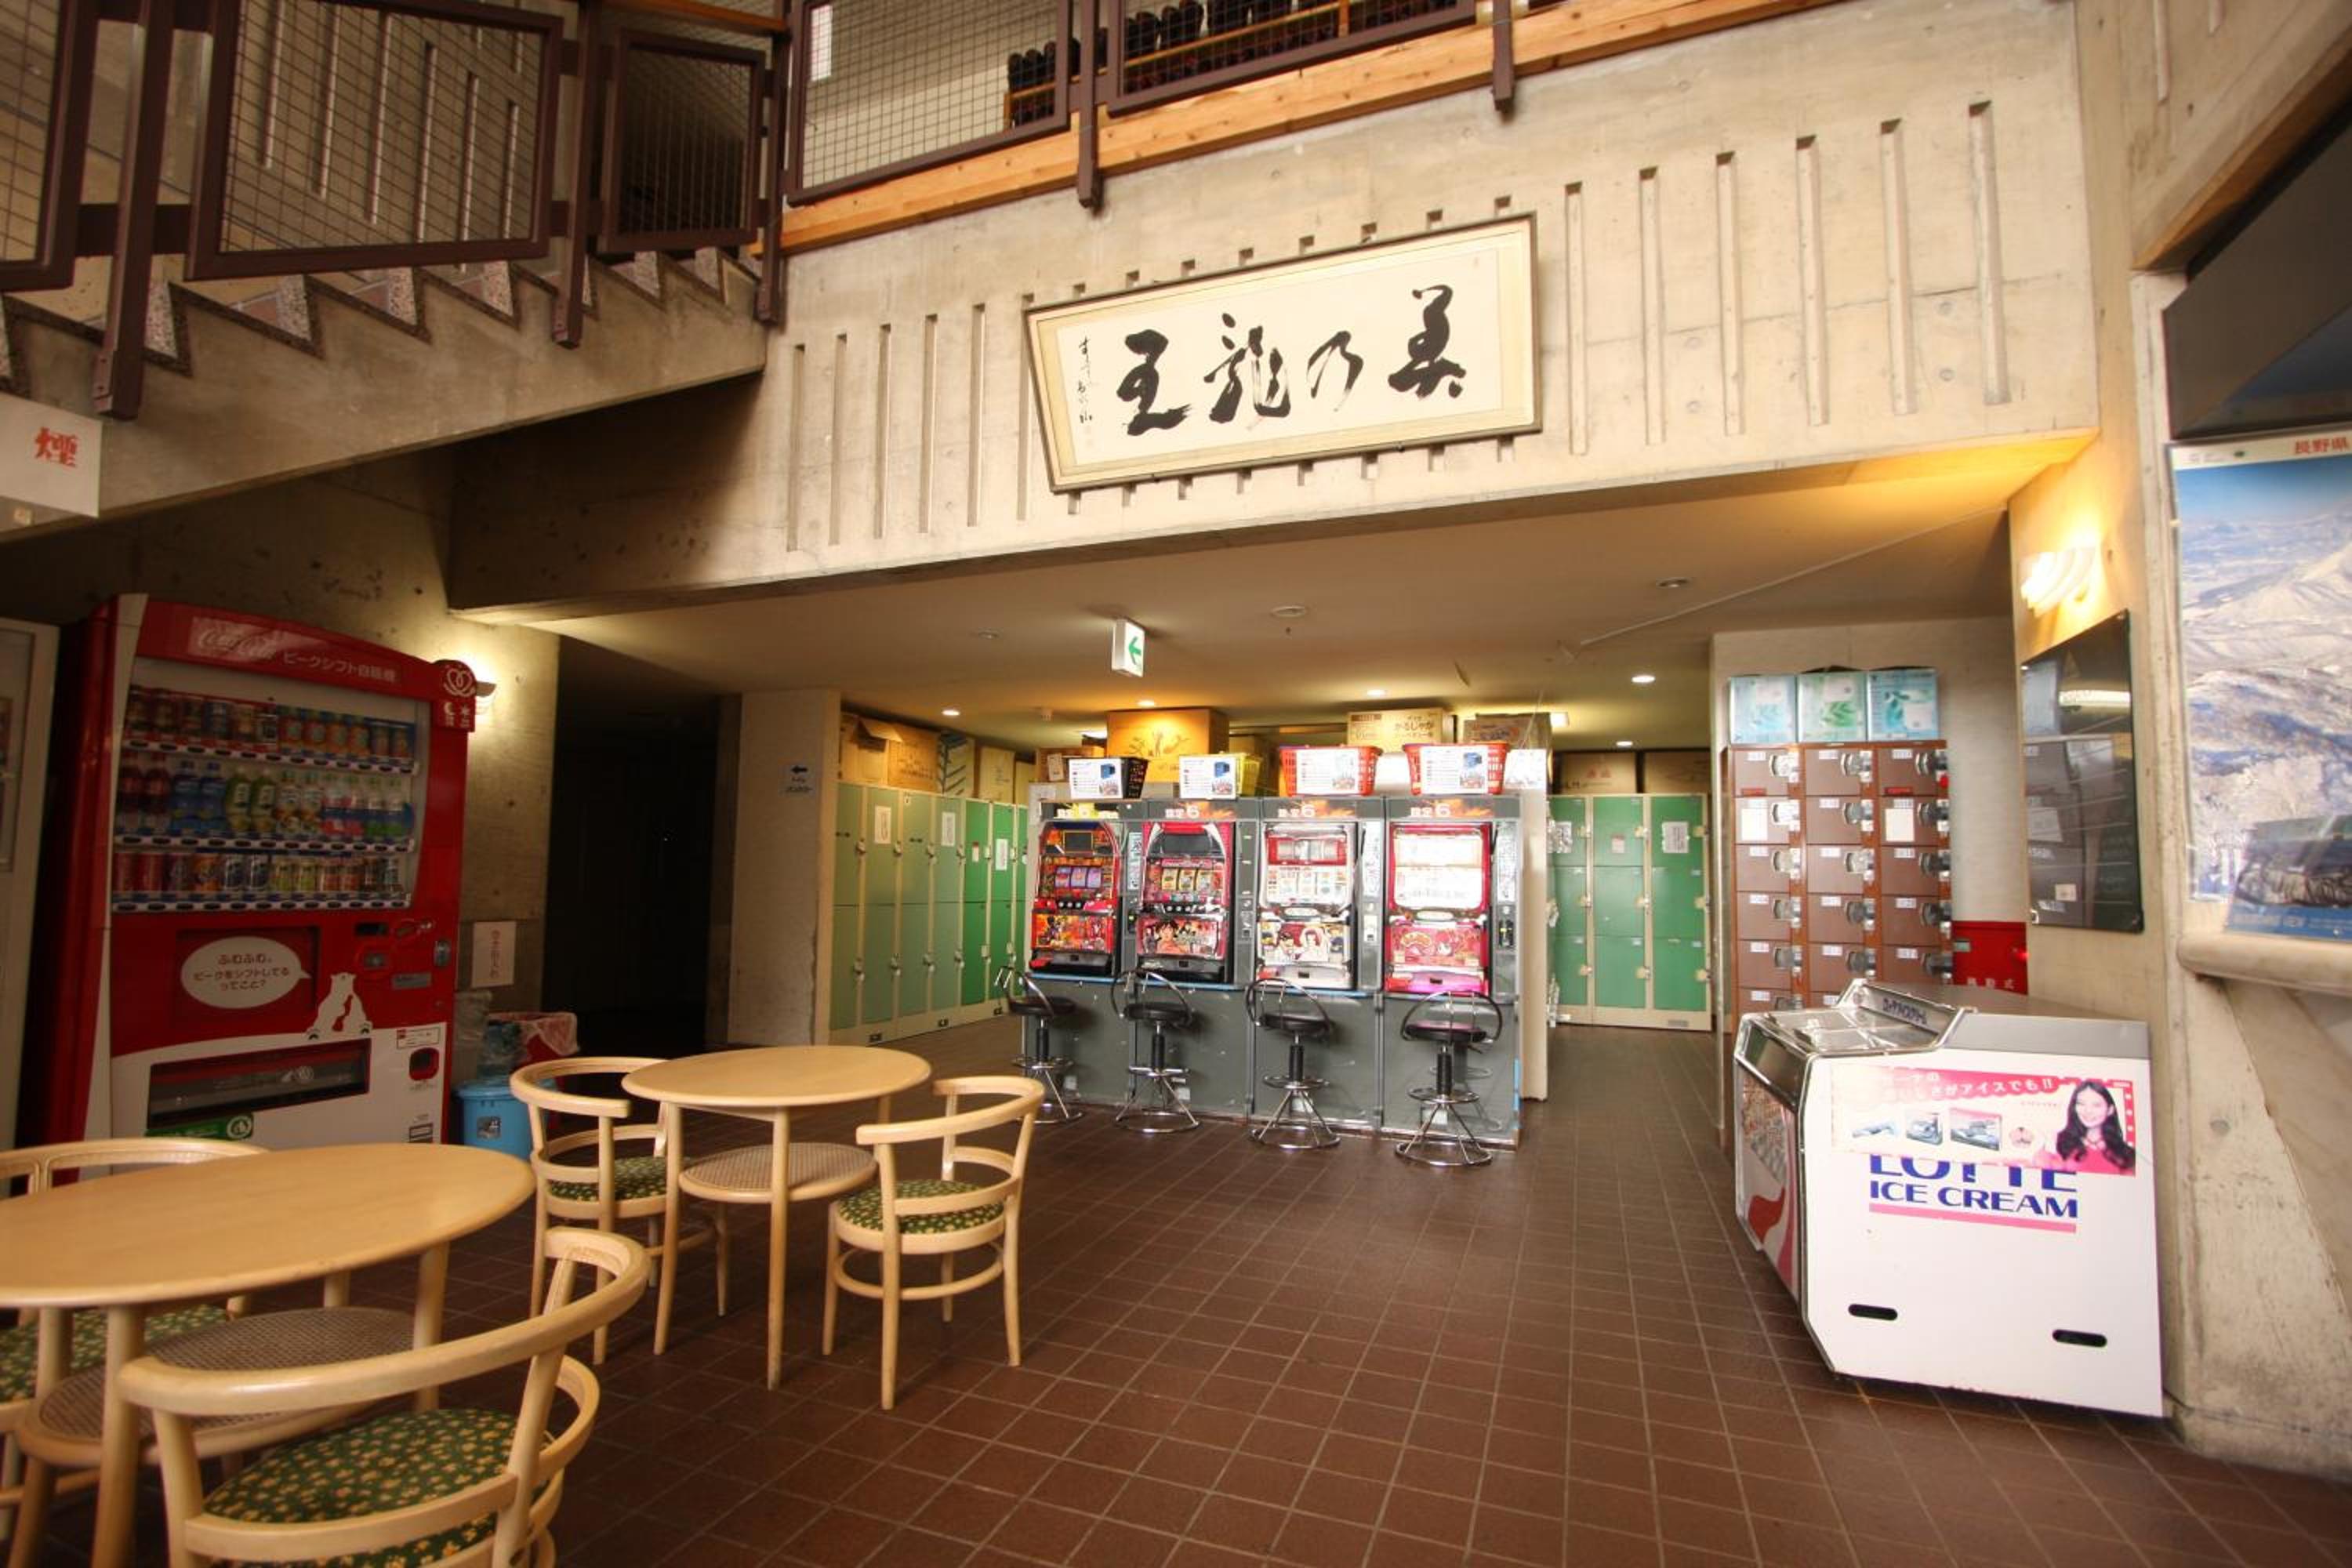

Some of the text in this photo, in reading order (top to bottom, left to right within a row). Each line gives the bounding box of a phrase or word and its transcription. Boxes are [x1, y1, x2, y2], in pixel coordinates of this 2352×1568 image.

[34, 426, 78, 468] 煙
[1871, 1181, 2078, 1218] ICE CREAM
